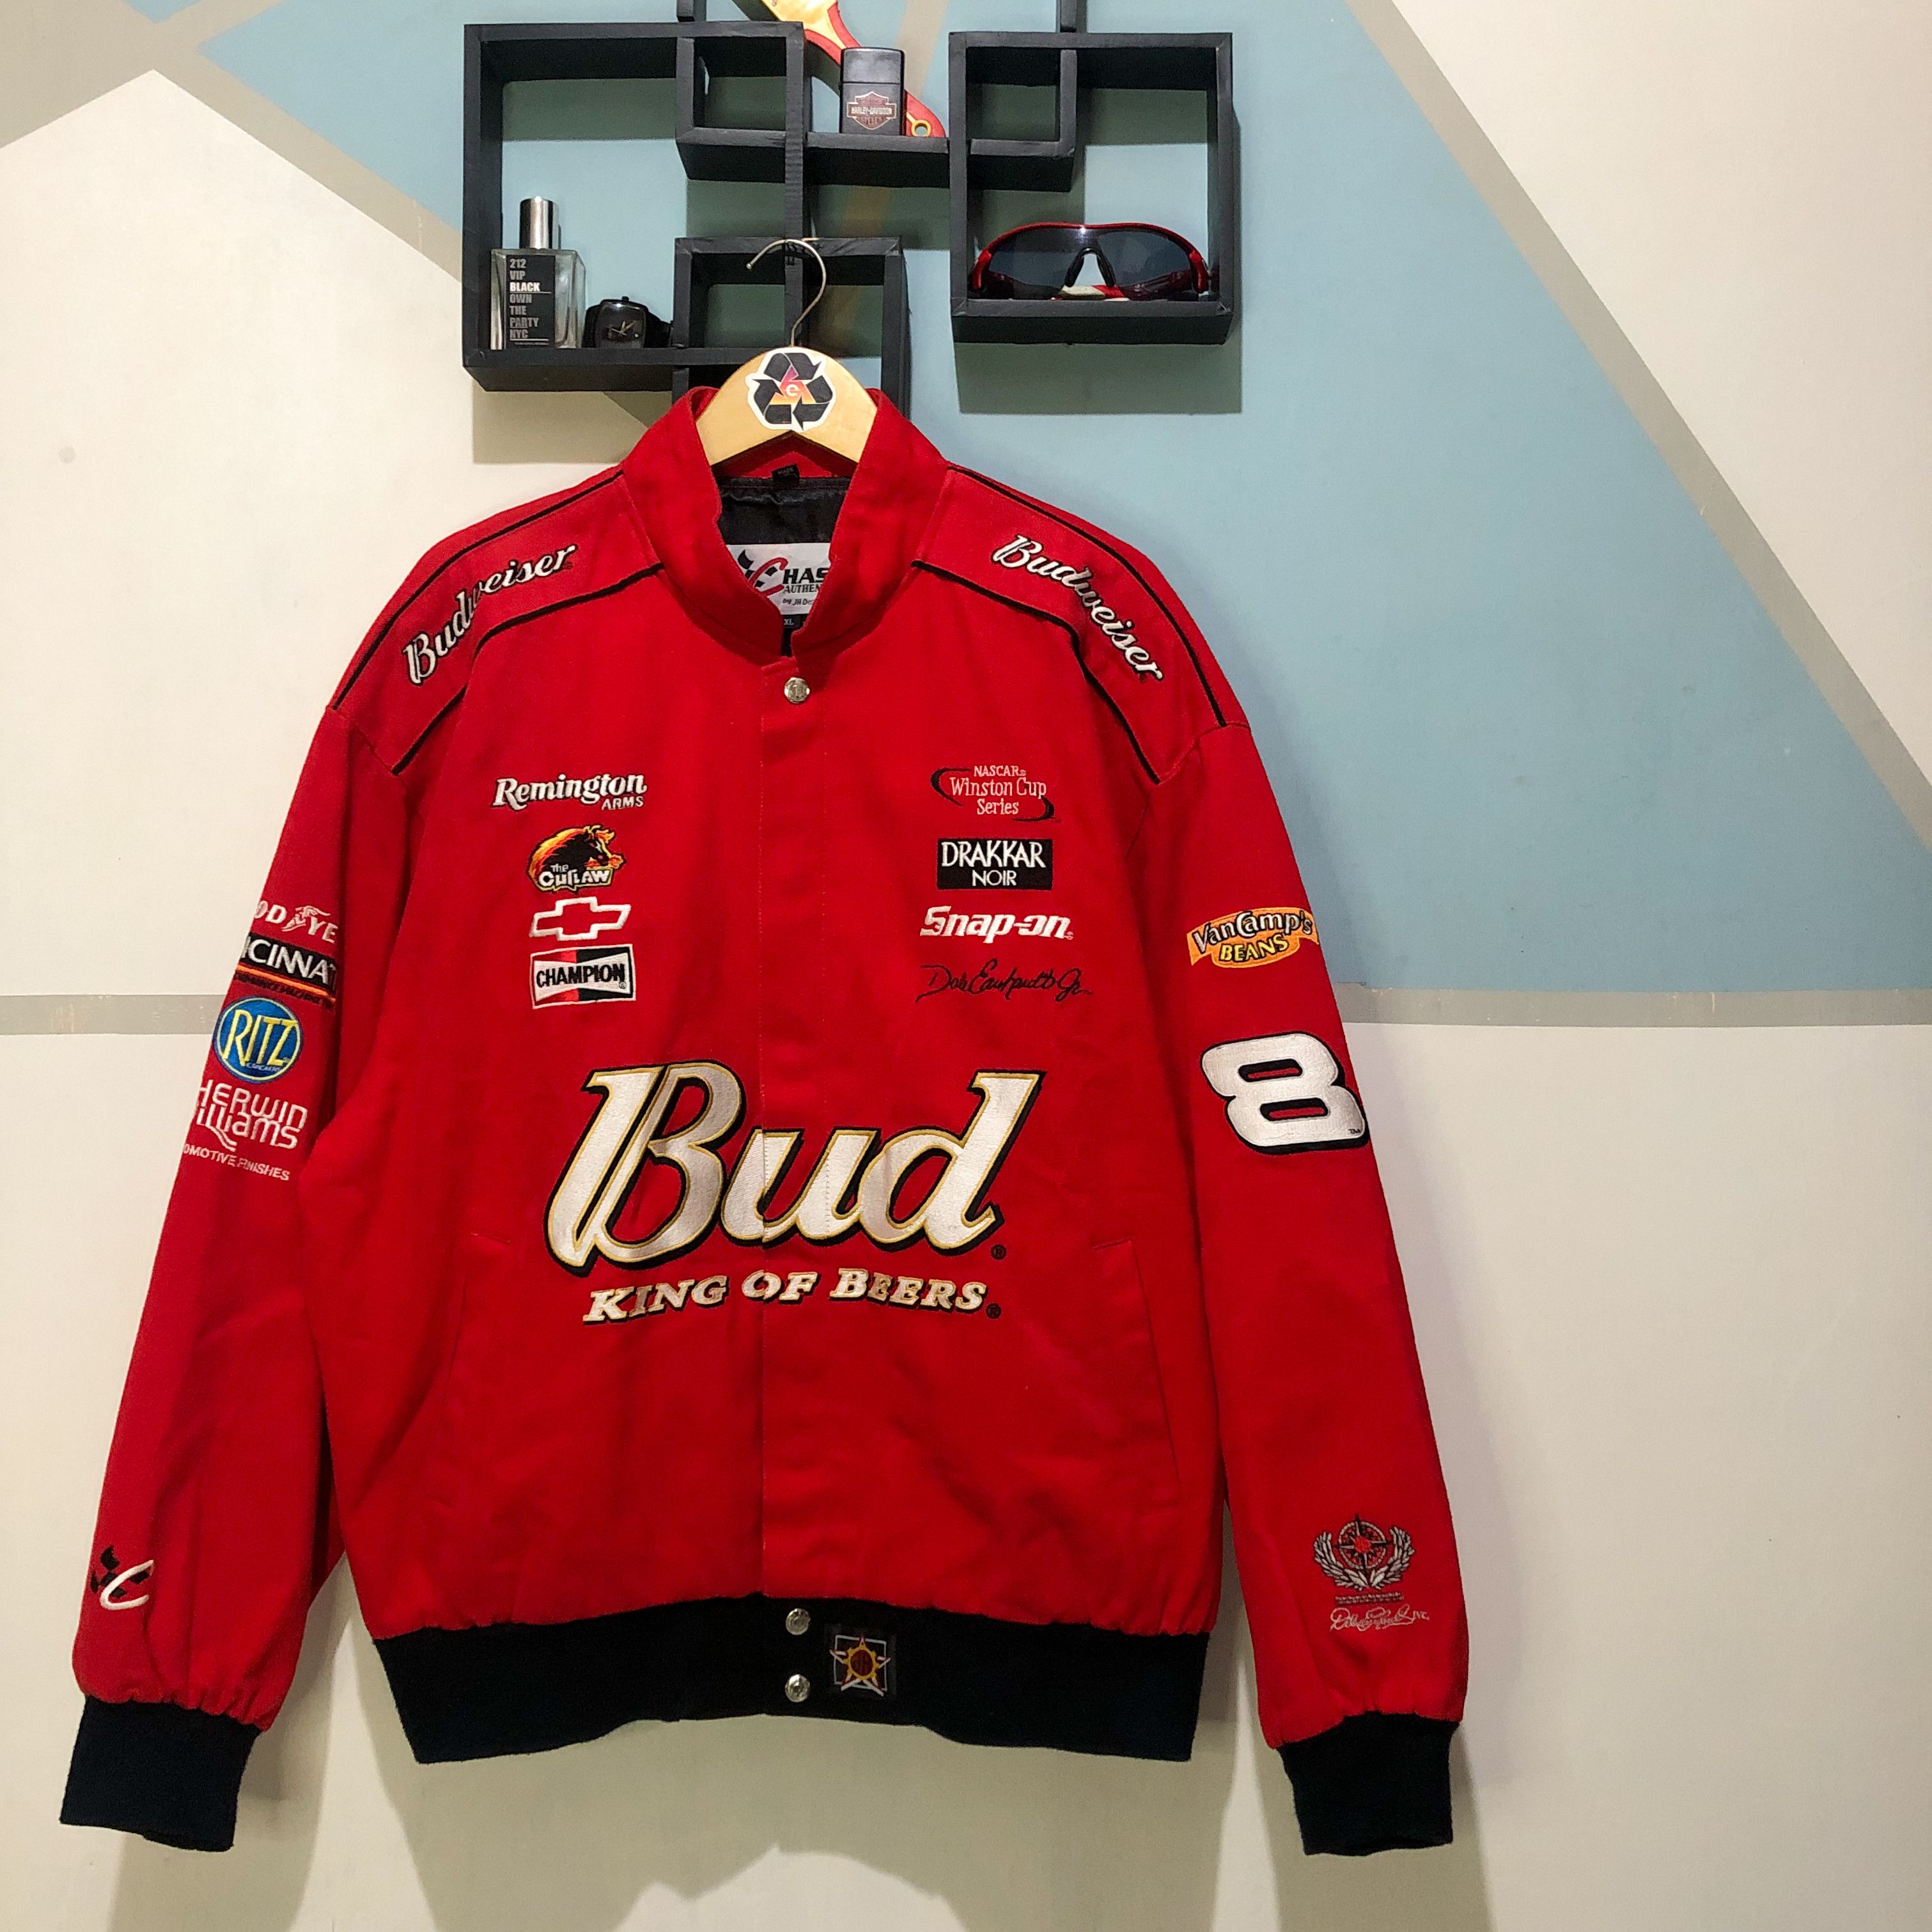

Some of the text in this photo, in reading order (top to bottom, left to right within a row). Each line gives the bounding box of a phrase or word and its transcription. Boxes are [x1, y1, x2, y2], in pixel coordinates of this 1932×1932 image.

[510, 258, 526, 269] 212
[510, 270, 526, 280] VIP
[510, 282, 540, 292] BLACK
[510, 294, 532, 304] OWN
[510, 306, 527, 315] THE
[510, 317, 539, 327] PARTY
[510, 329, 528, 339] NYC
[403, 545, 577, 684] Budweiser
[992, 534, 1163, 680] Budweiser
[974, 765, 1019, 777] NASCAR
[492, 773, 648, 811] Remington
[950, 777, 1047, 799] Winston Cup
[602, 795, 644, 811] ARMS
[977, 798, 1019, 815] Series
[941, 840, 1047, 868] DRAKKAR
[972, 869, 1017, 887] NOIR
[919, 905, 1071, 944] Snap-on
[1219, 933, 1289, 962] BEANS
[536, 963, 625, 988] CHAMPION
[222, 1009, 298, 1066] RITZ
[1200, 1029, 1370, 1155] 8
[237, 1157, 290, 1181] FINISHES
[544, 1059, 1047, 1277] Bud
[582, 1268, 988, 1323] KING OF BEERS
